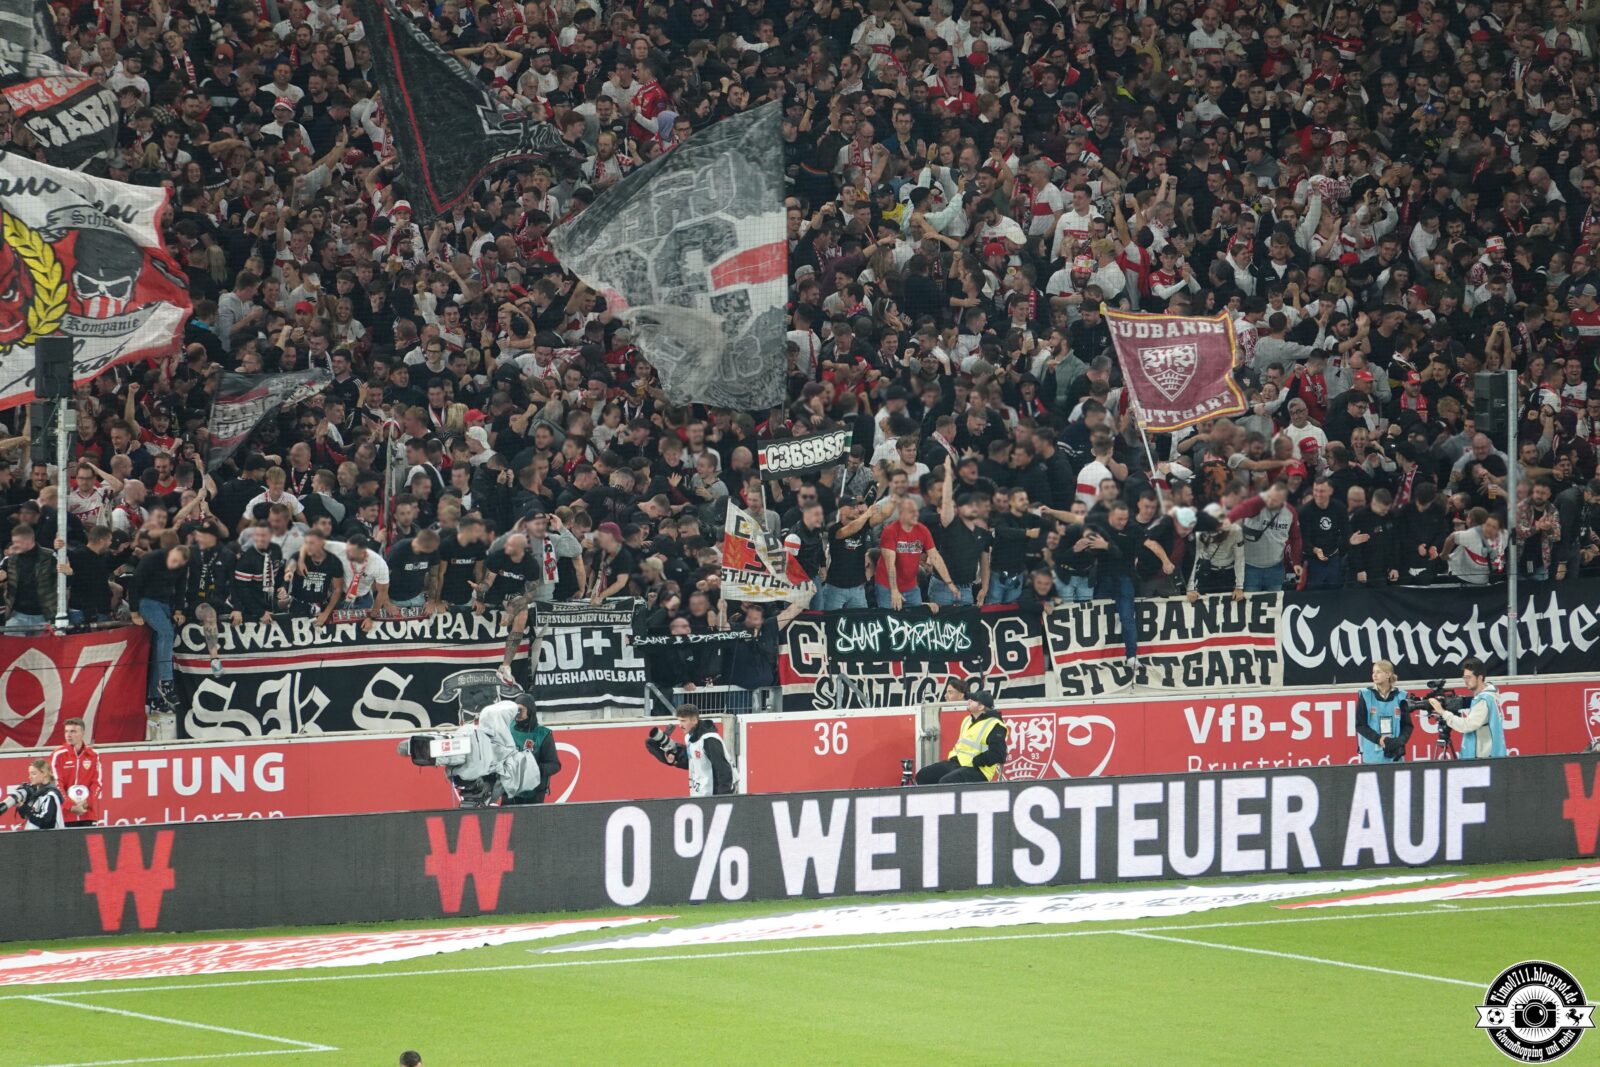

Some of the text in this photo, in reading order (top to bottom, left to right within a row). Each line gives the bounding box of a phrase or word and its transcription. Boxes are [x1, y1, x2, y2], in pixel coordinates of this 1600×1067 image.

[66, 317, 141, 333] Kompanie
[537, 613, 632, 624] VERSTORBENEN ULTRAS
[1050, 592, 1278, 652] SÜDBANDE
[1282, 590, 1600, 669] Cannstatte
[457, 675, 497, 685] Schwaben
[1060, 649, 1278, 697] STUTTGART
[811, 676, 1008, 711] STUTTGRT
[813, 720, 848, 756] 36
[772, 775, 1321, 896] WETTSTEUER
[1342, 766, 1491, 867] AUF
